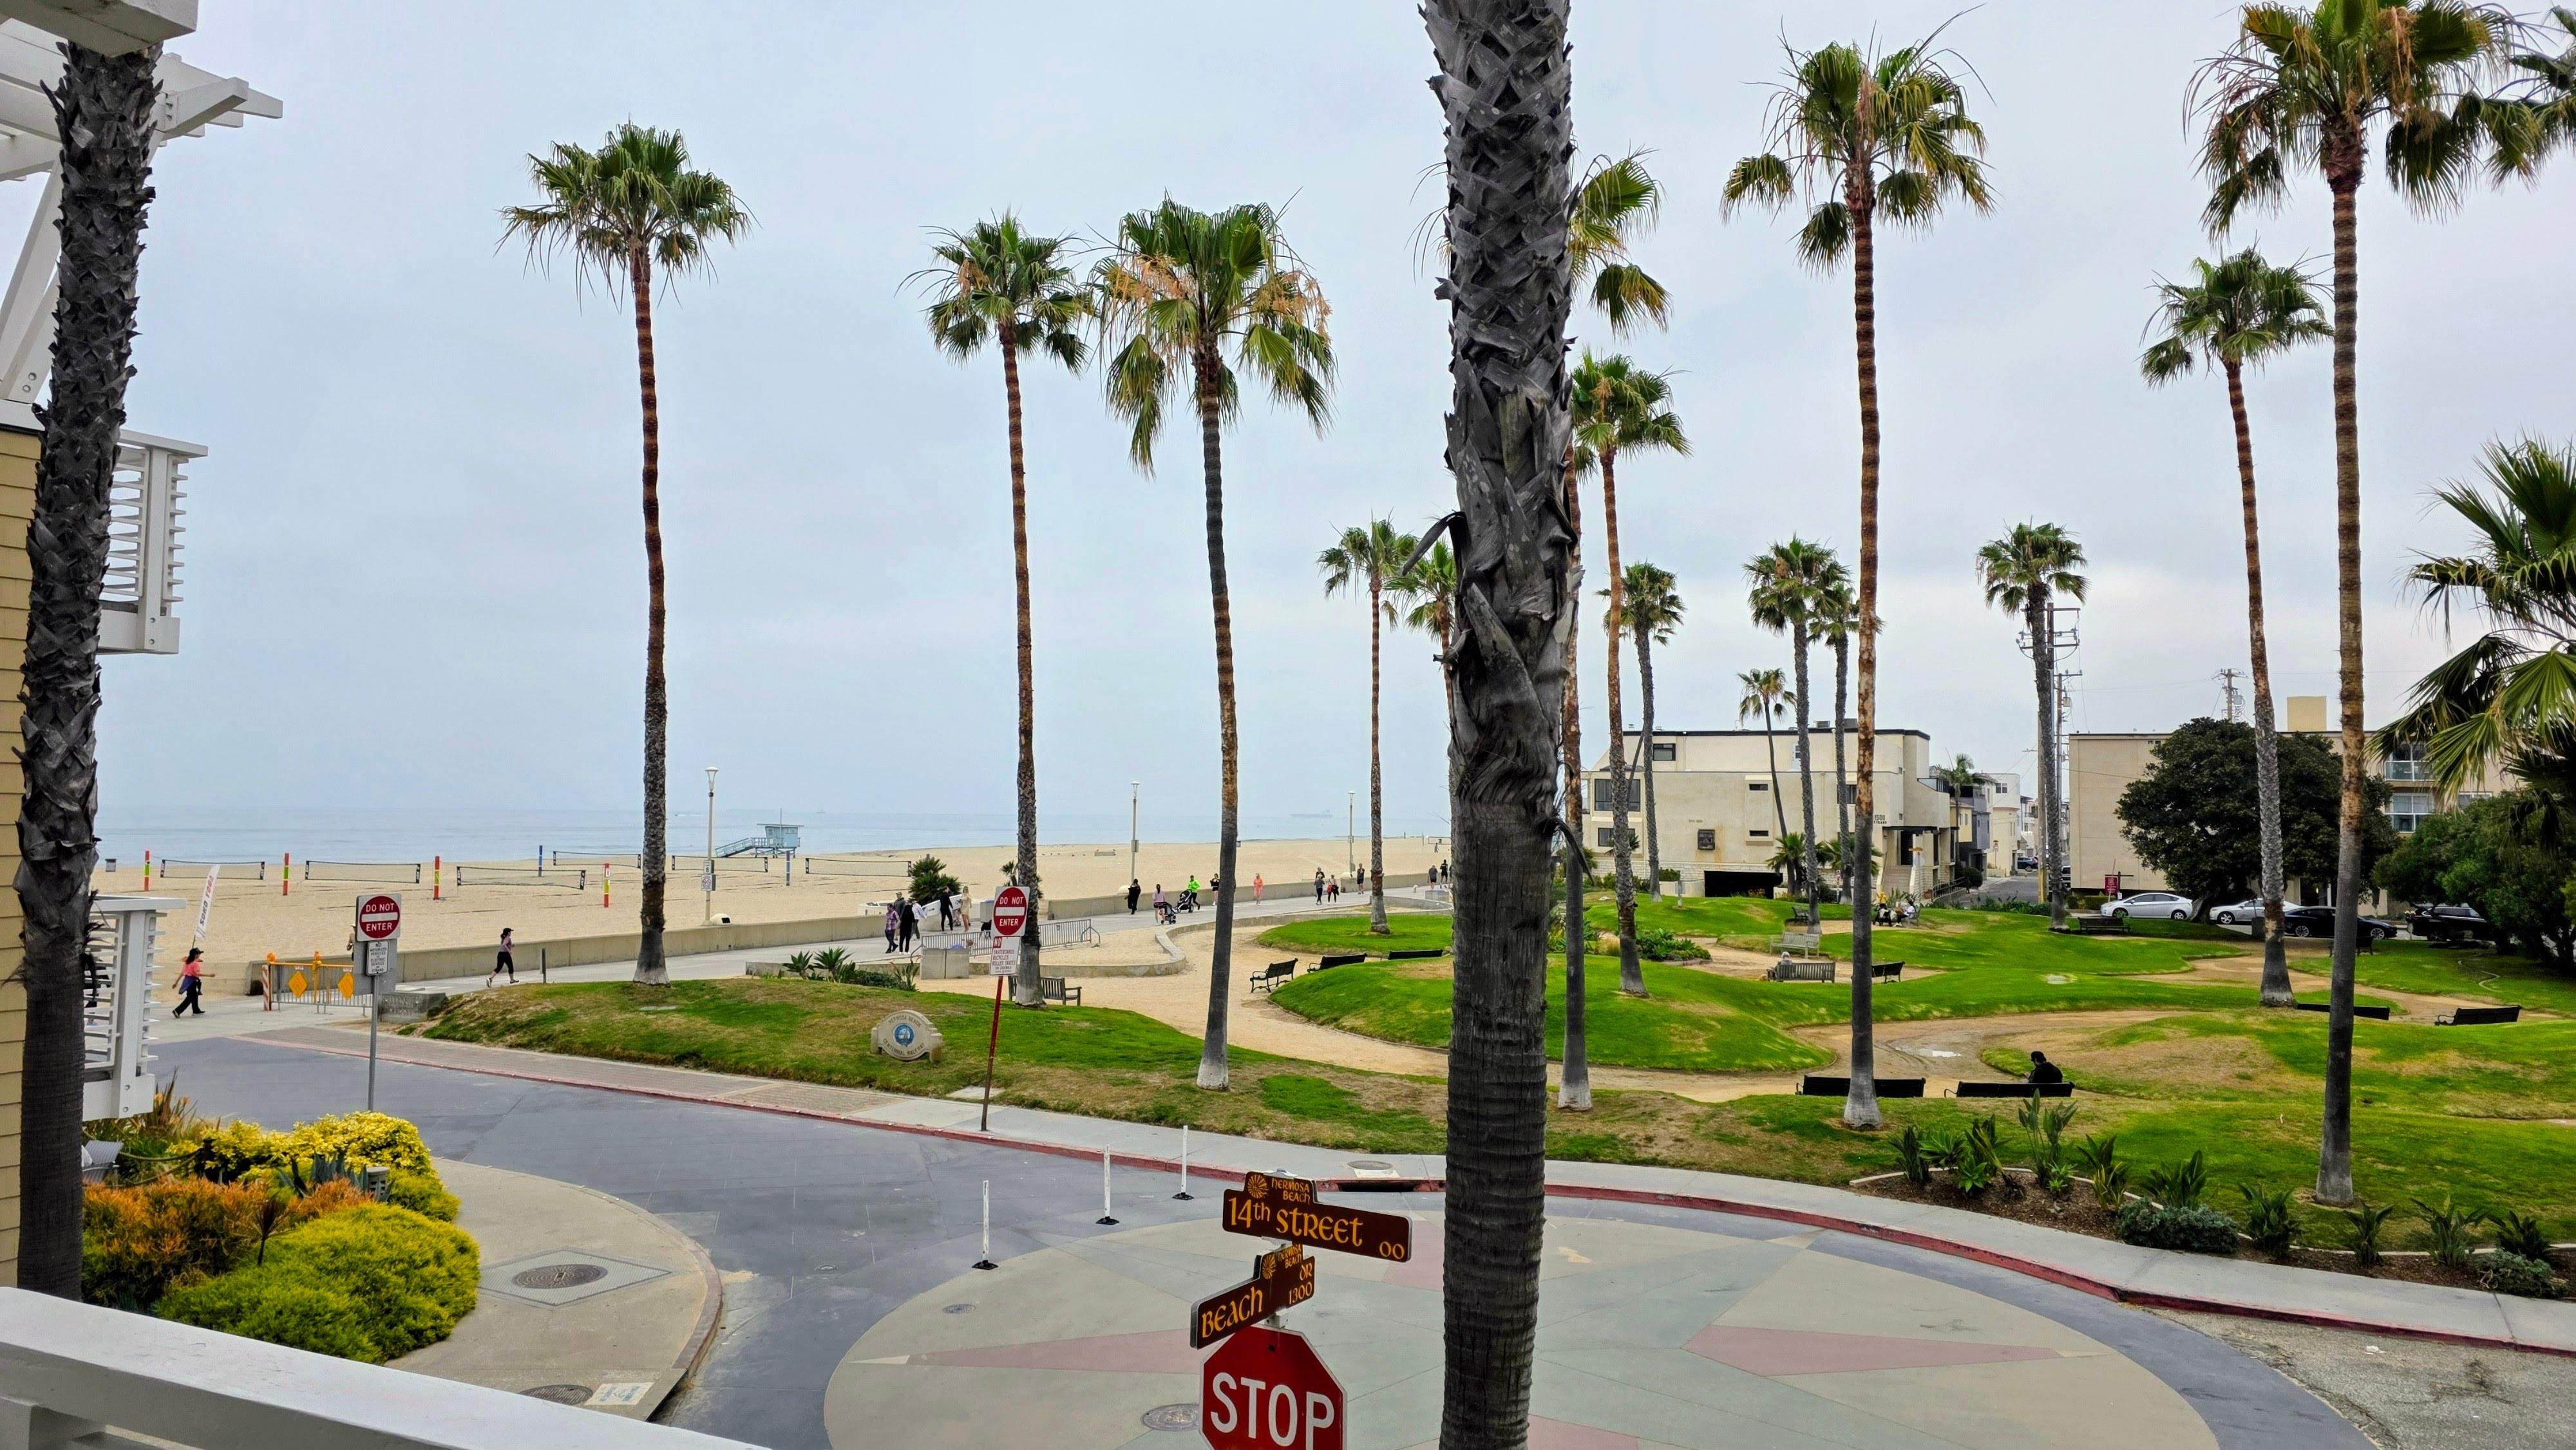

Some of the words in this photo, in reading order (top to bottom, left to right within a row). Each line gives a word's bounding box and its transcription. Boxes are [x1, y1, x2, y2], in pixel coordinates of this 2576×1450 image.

[1012, 896, 1024, 905] NOT
[366, 904, 377, 912] DO
[379, 903, 395, 912] NOT
[366, 922, 392, 932] ENTER
[999, 918, 1018, 927] ENTER
[994, 937, 1001, 946] NO
[1300, 1263, 1312, 1280] DR
[1289, 1282, 1312, 1304] 1300
[1211, 1372, 1334, 1450] STOP
